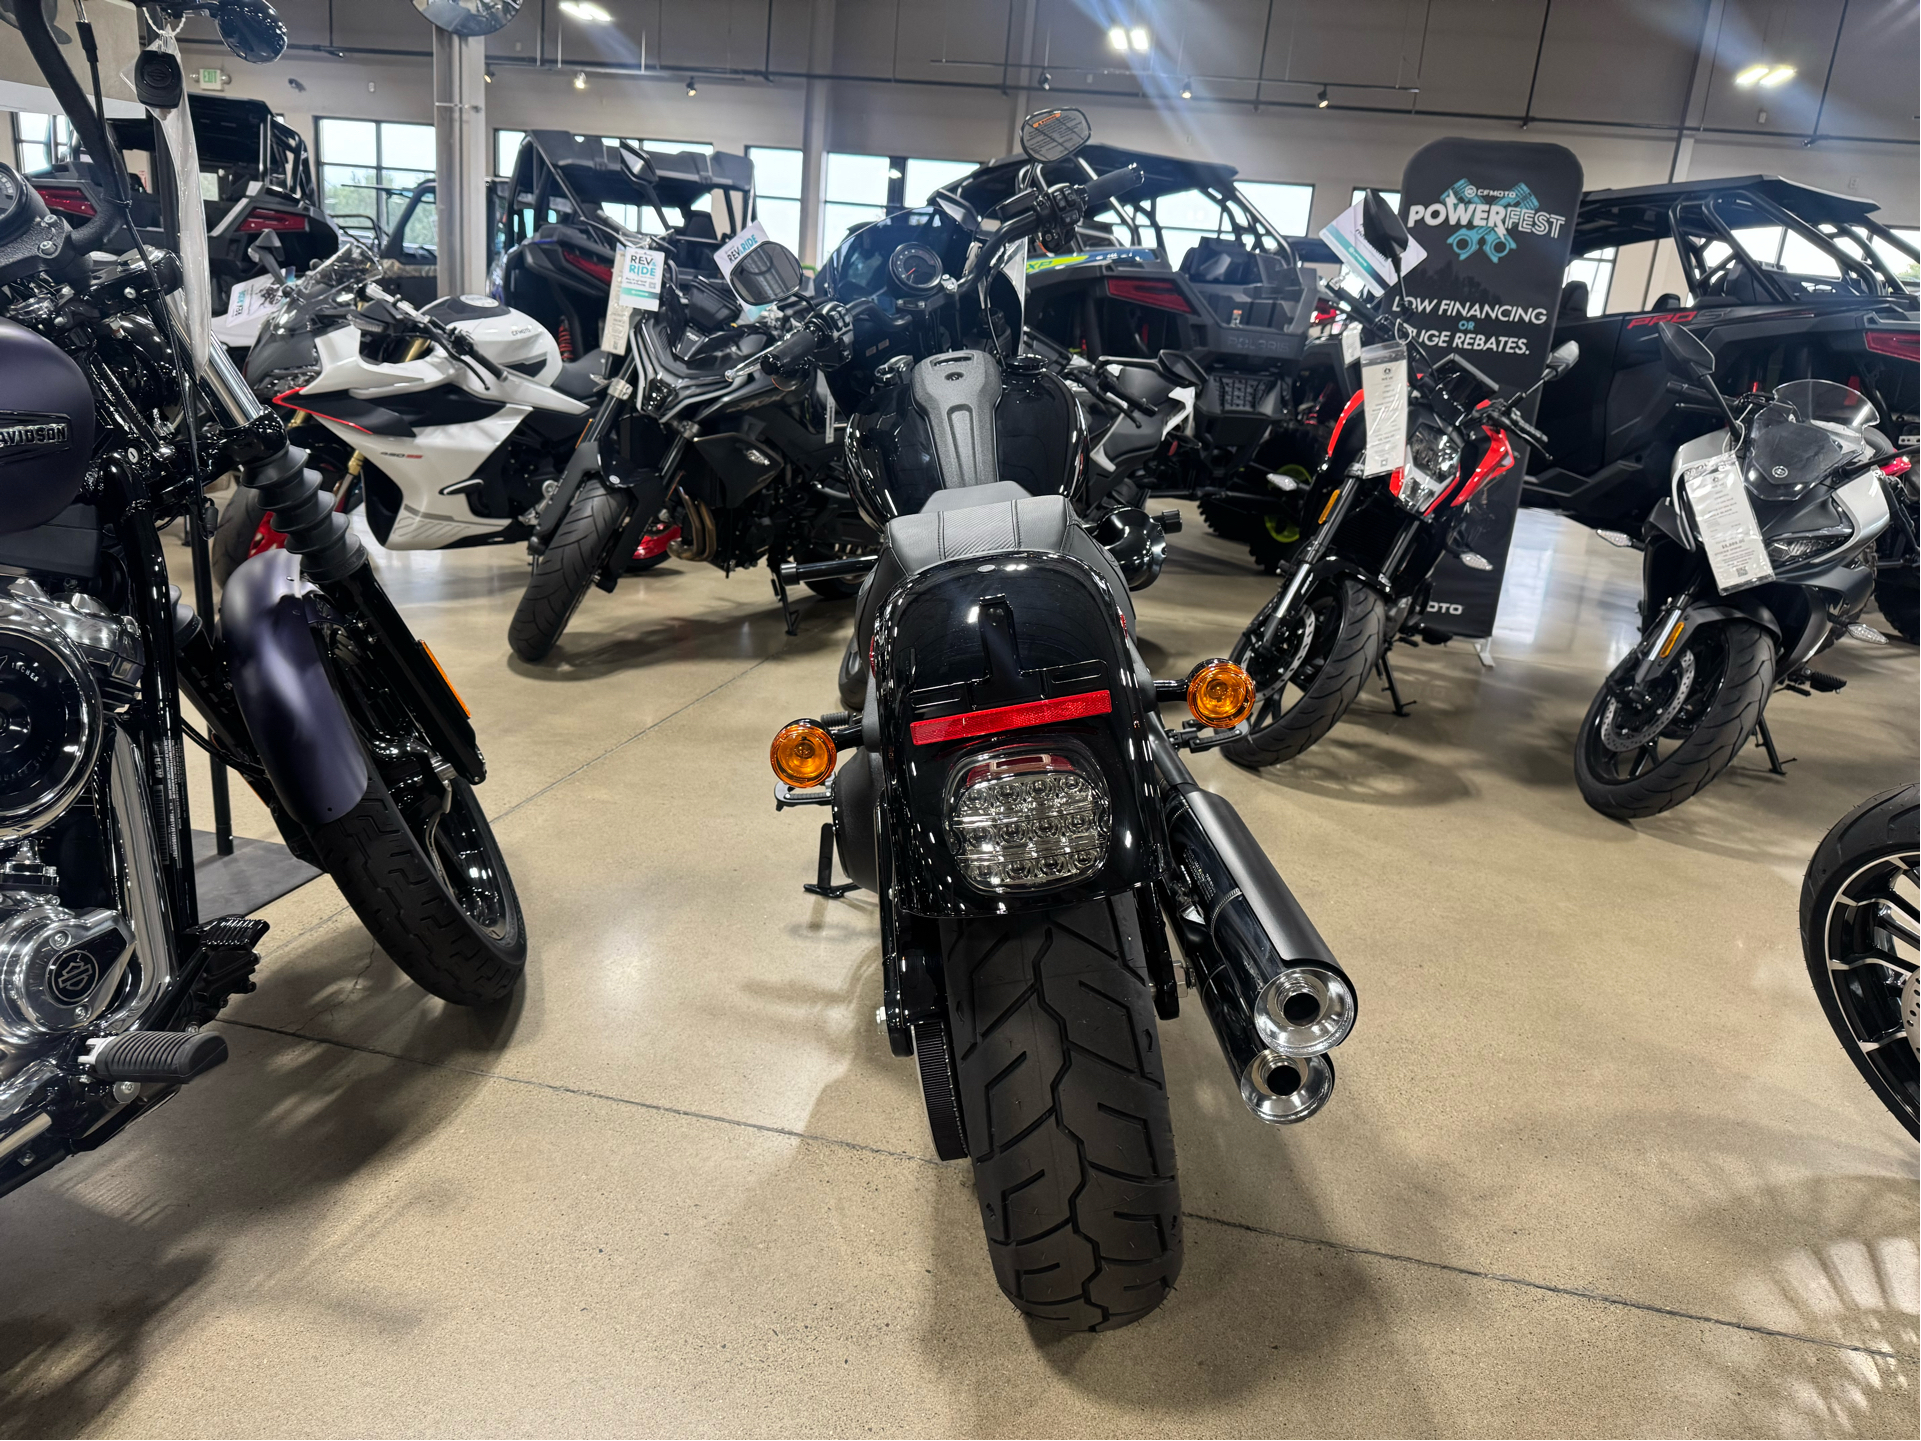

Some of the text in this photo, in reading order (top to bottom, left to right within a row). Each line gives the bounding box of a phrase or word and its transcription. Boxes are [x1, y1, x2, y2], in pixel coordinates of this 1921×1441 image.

[1477, 188, 1516, 198] CFMOTO
[628, 264, 657, 278] RIDE
[1438, 299, 1548, 325] FINANCING
[1458, 320, 1475, 331] OR
[1228, 336, 1290, 353] POLARIS
[1452, 332, 1530, 355] REBATES.
[1427, 601, 1464, 615] OTO
